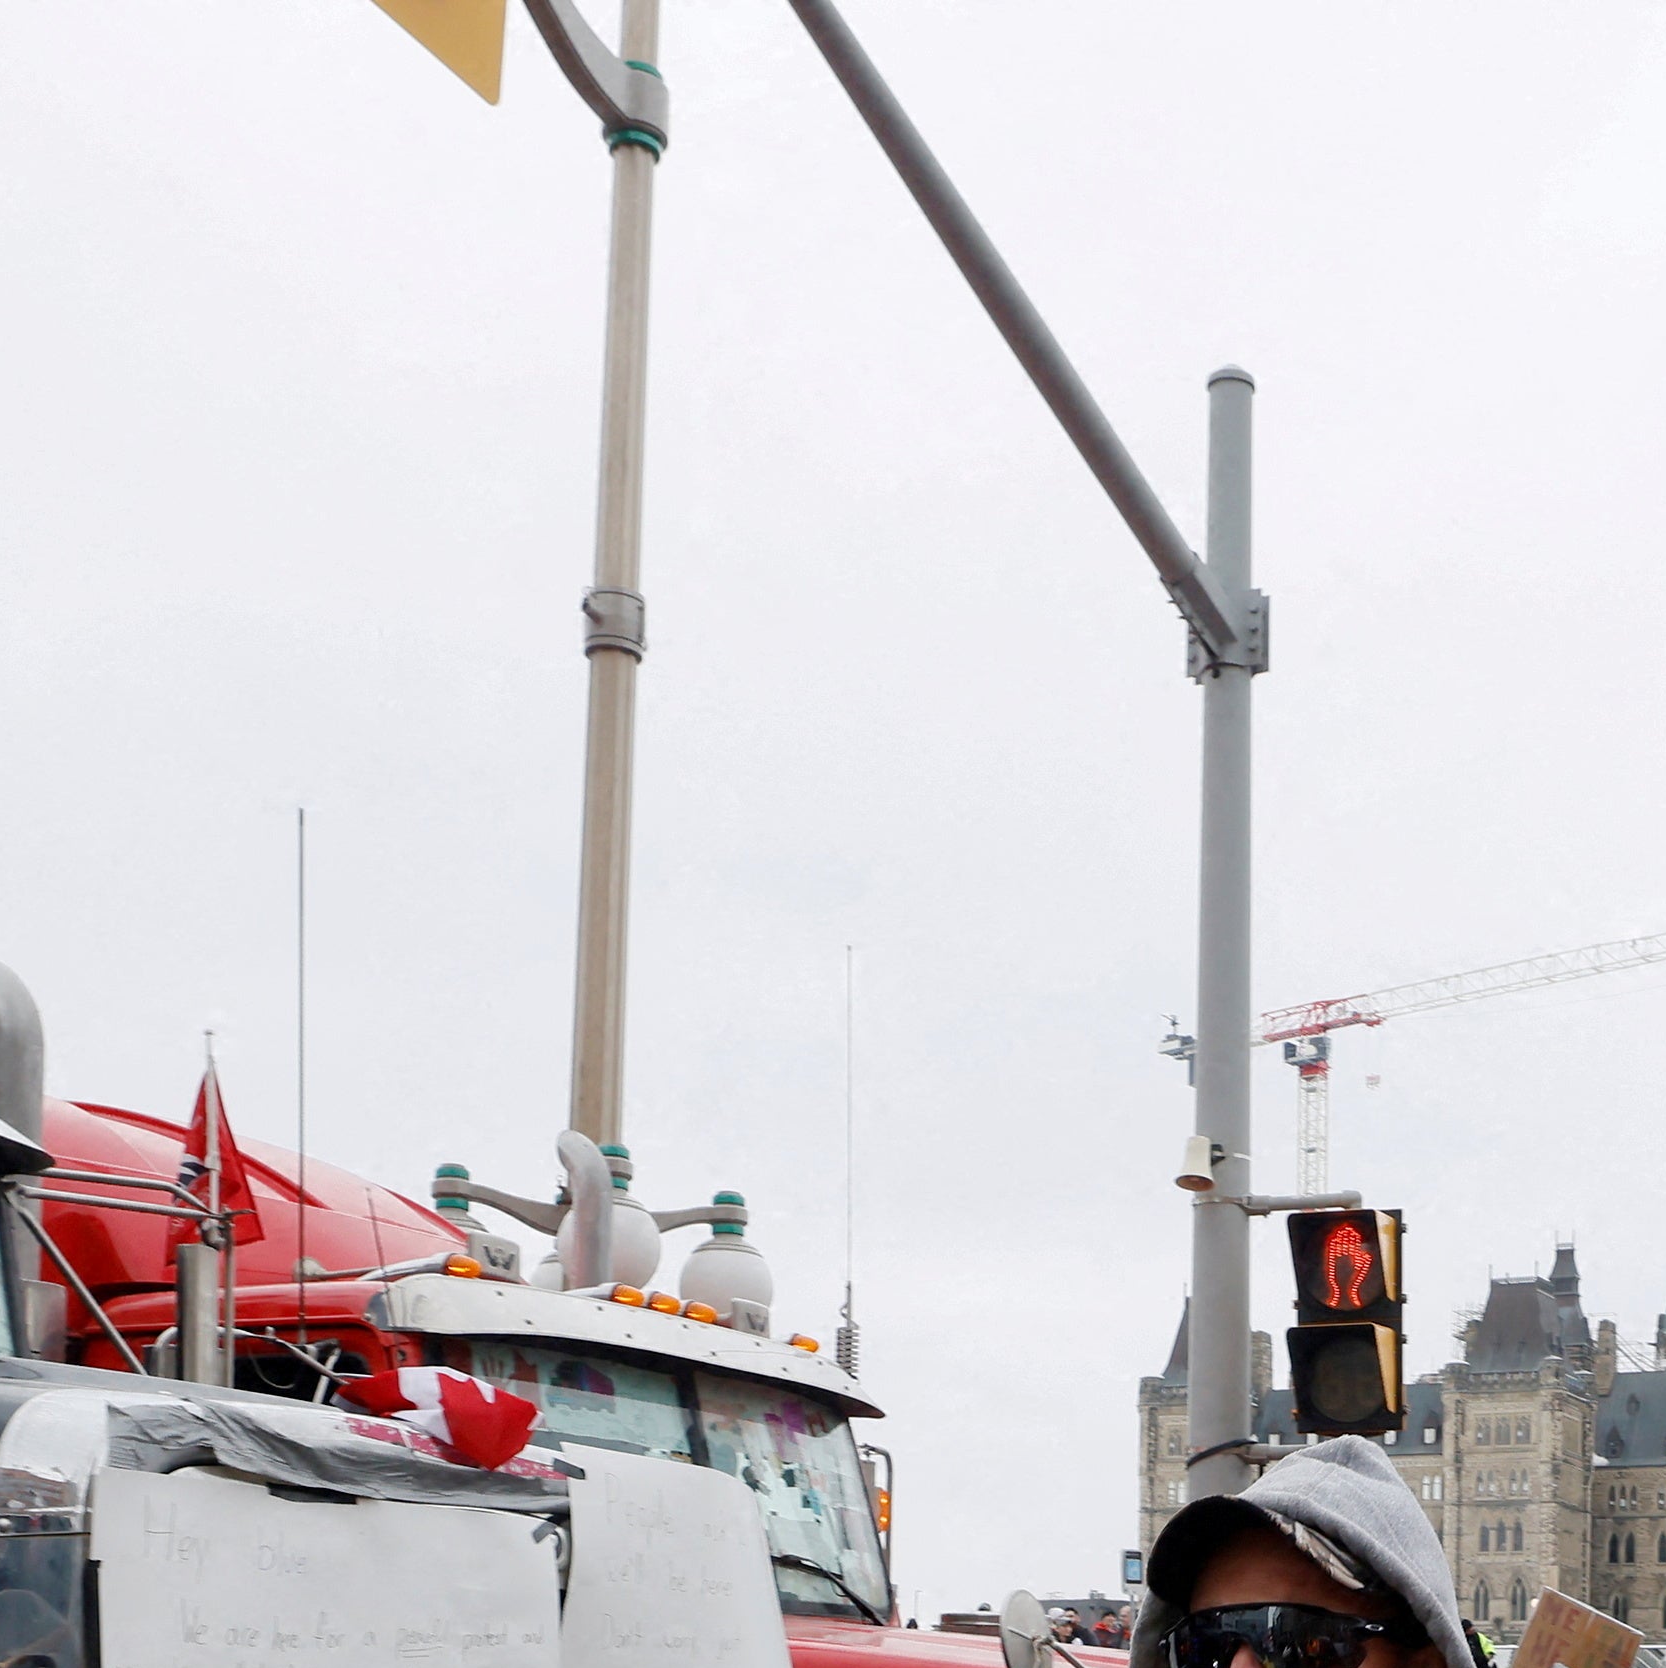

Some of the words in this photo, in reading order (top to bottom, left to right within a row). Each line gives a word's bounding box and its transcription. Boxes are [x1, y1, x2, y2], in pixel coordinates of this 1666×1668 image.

[144, 1495, 209, 1584] Hey
[177, 1599, 208, 1647] We
[225, 1624, 259, 1648] are
[273, 1615, 299, 1650] here
[314, 1611, 346, 1649] for
[363, 1627, 377, 1646] a
